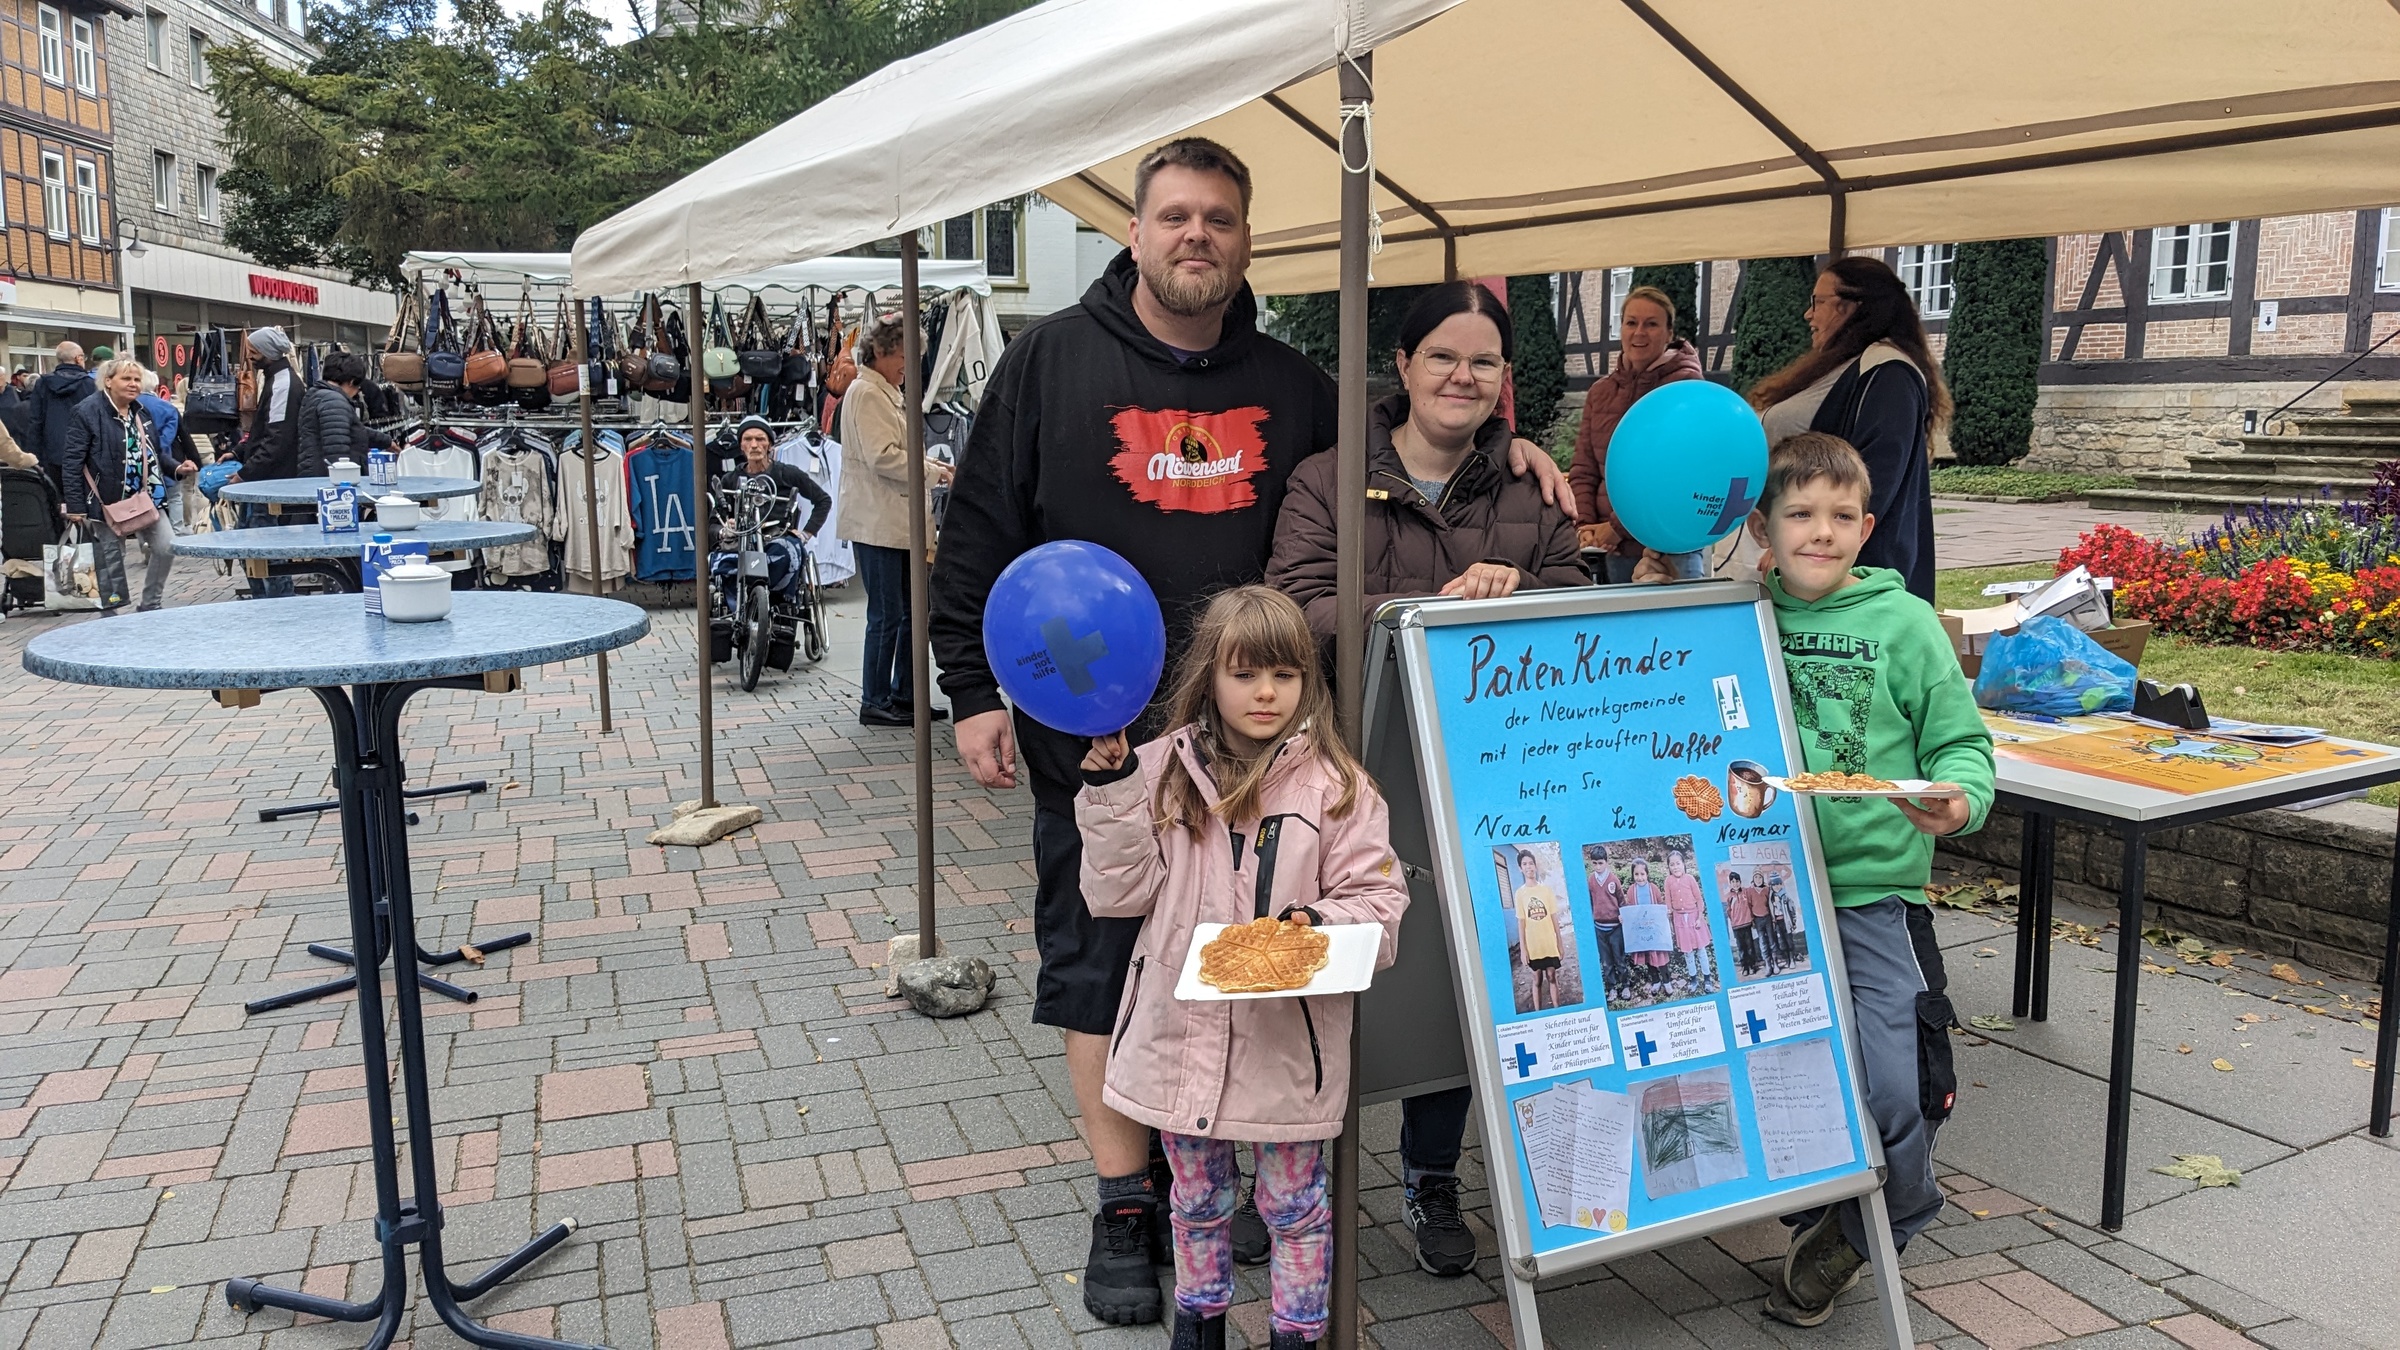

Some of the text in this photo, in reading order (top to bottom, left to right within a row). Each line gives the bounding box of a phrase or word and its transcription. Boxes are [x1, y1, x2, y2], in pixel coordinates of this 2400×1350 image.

[248, 274, 319, 305] WOOLWORTH
[1172, 428, 1213, 447] ORIGINAL
[1147, 450, 1243, 480] Möwensenf
[1172, 476, 1226, 488] NORDDEICH
[1693, 492, 1725, 503] kinder
[644, 474, 694, 553] LA
[1697, 509, 1720, 517] hilfe
[1780, 632, 1879, 661] NECRAFT
[1016, 649, 1048, 666] kinder
[1034, 658, 1052, 669] not
[1032, 666, 1056, 680] hilfe
[1505, 692, 1686, 730] der Neuwerkgemeinde
[1480, 729, 1722, 765] mit jeder gekauften Waffel
[1519, 771, 1602, 800] helfen Sie
[1612, 806, 1636, 829] Liz
[1474, 815, 1551, 840] Noah
[1716, 822, 1791, 844] Neymar
[1732, 846, 1788, 860] EL AGUA
[1771, 977, 1808, 991] Bildung und
[1773, 988, 1808, 1000] Teilhabe für
[1664, 1004, 1715, 1019] Ein gewaltfreies
[1776, 998, 1810, 1010] Kinder und
[1777, 1007, 1812, 1021] Jugendliche
[1544, 1014, 1591, 1030] Sicherheit und
[1666, 1016, 1702, 1028] Umfeld für
[1779, 1015, 1828, 1029] Westen Boliviens
[1546, 1024, 1599, 1040] Perspektiven für
[1669, 1028, 1698, 1040] Familien
[1548, 1035, 1600, 1050] Kinder und ihre
[1671, 1038, 1697, 1049] Bolivien
[1550, 1043, 1609, 1062] Familien im Süden
[1672, 1047, 1699, 1059] schaffen
[1552, 1055, 1602, 1071] der Philippinen
